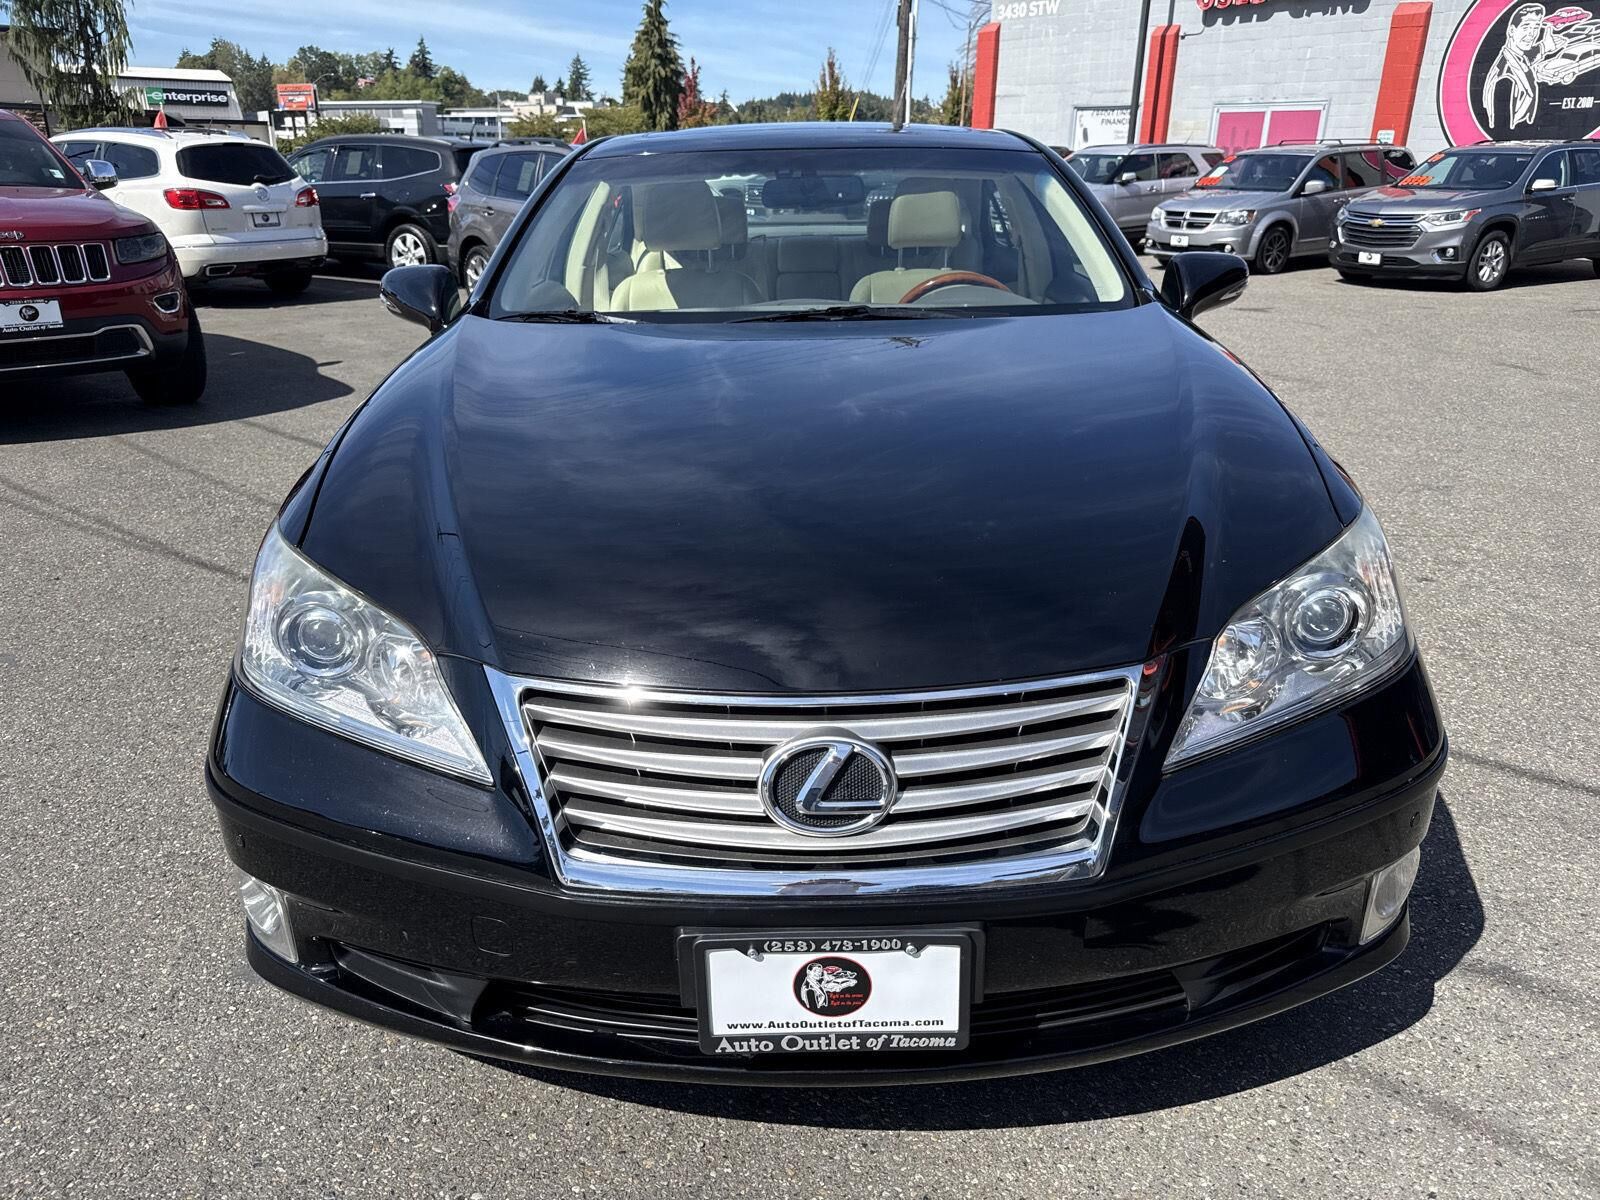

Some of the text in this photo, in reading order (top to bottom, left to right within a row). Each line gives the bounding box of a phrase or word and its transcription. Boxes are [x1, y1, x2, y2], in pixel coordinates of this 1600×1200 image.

[998, 3, 1027, 19] 3430
[151, 90, 228, 104] enterprise
[763, 938, 902, 953] (253) 473-1900
[726, 1019, 944, 1030] www.AutoOutletofTacoma.com
[715, 1033, 957, 1053] Auto Outlet of Tacoma
